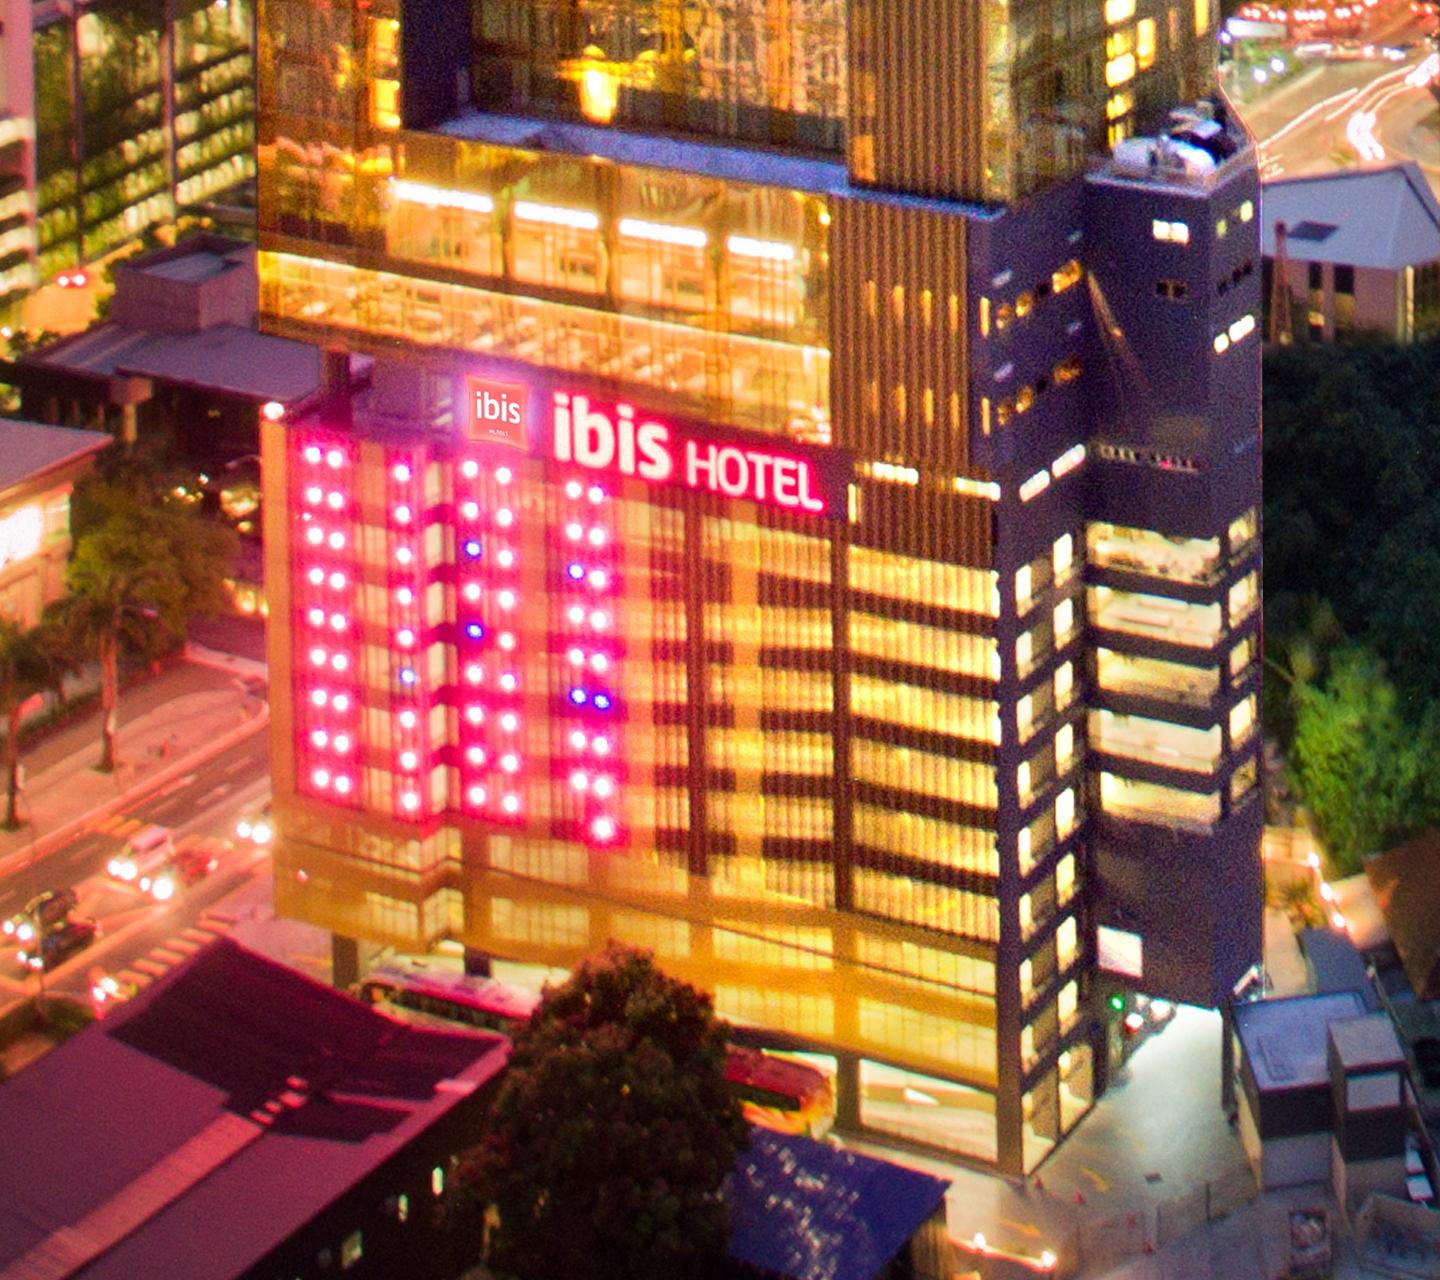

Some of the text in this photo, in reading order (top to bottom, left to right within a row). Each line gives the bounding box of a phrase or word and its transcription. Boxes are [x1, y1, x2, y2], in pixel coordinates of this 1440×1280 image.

[475, 390, 521, 425] ibis
[553, 391, 824, 512] ibis HOTEL
